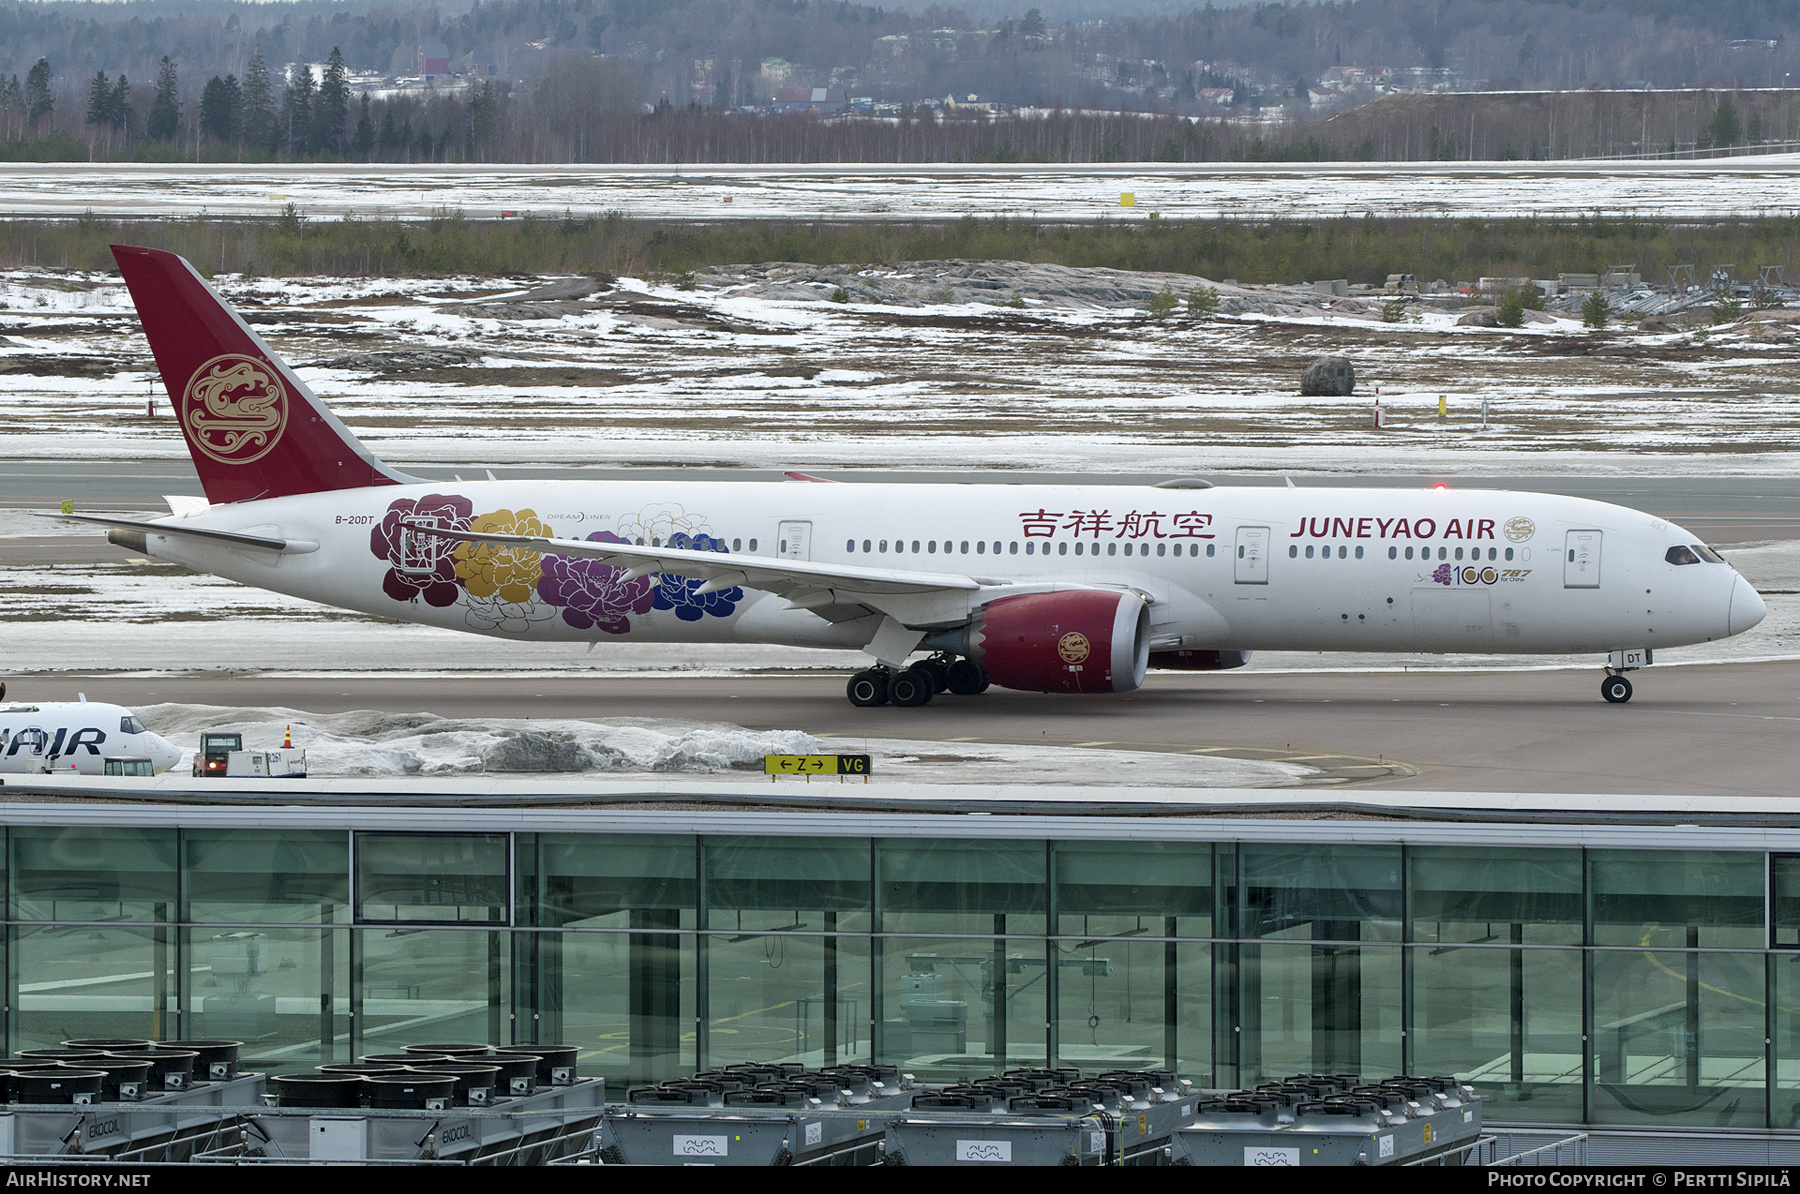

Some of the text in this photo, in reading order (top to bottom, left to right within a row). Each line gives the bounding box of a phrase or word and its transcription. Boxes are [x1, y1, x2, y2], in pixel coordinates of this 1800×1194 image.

[335, 515, 374, 525] B-20DT
[1018, 508, 1216, 539] 吉祥航空
[1290, 517, 1496, 540] JUNEYAO AIR
[1501, 569, 1532, 578] 787
[1627, 653, 1641, 663] DT
[0, 727, 107, 756] AIR
[797, 758, 806, 771] Z
[843, 758, 863, 772] VG
[89, 1119, 120, 1138] EKOCOIL
[442, 1124, 471, 1144] EKOCOIL
[683, 1146, 720, 1154] LAVAL
[967, 1151, 1004, 1160] LAVAL
